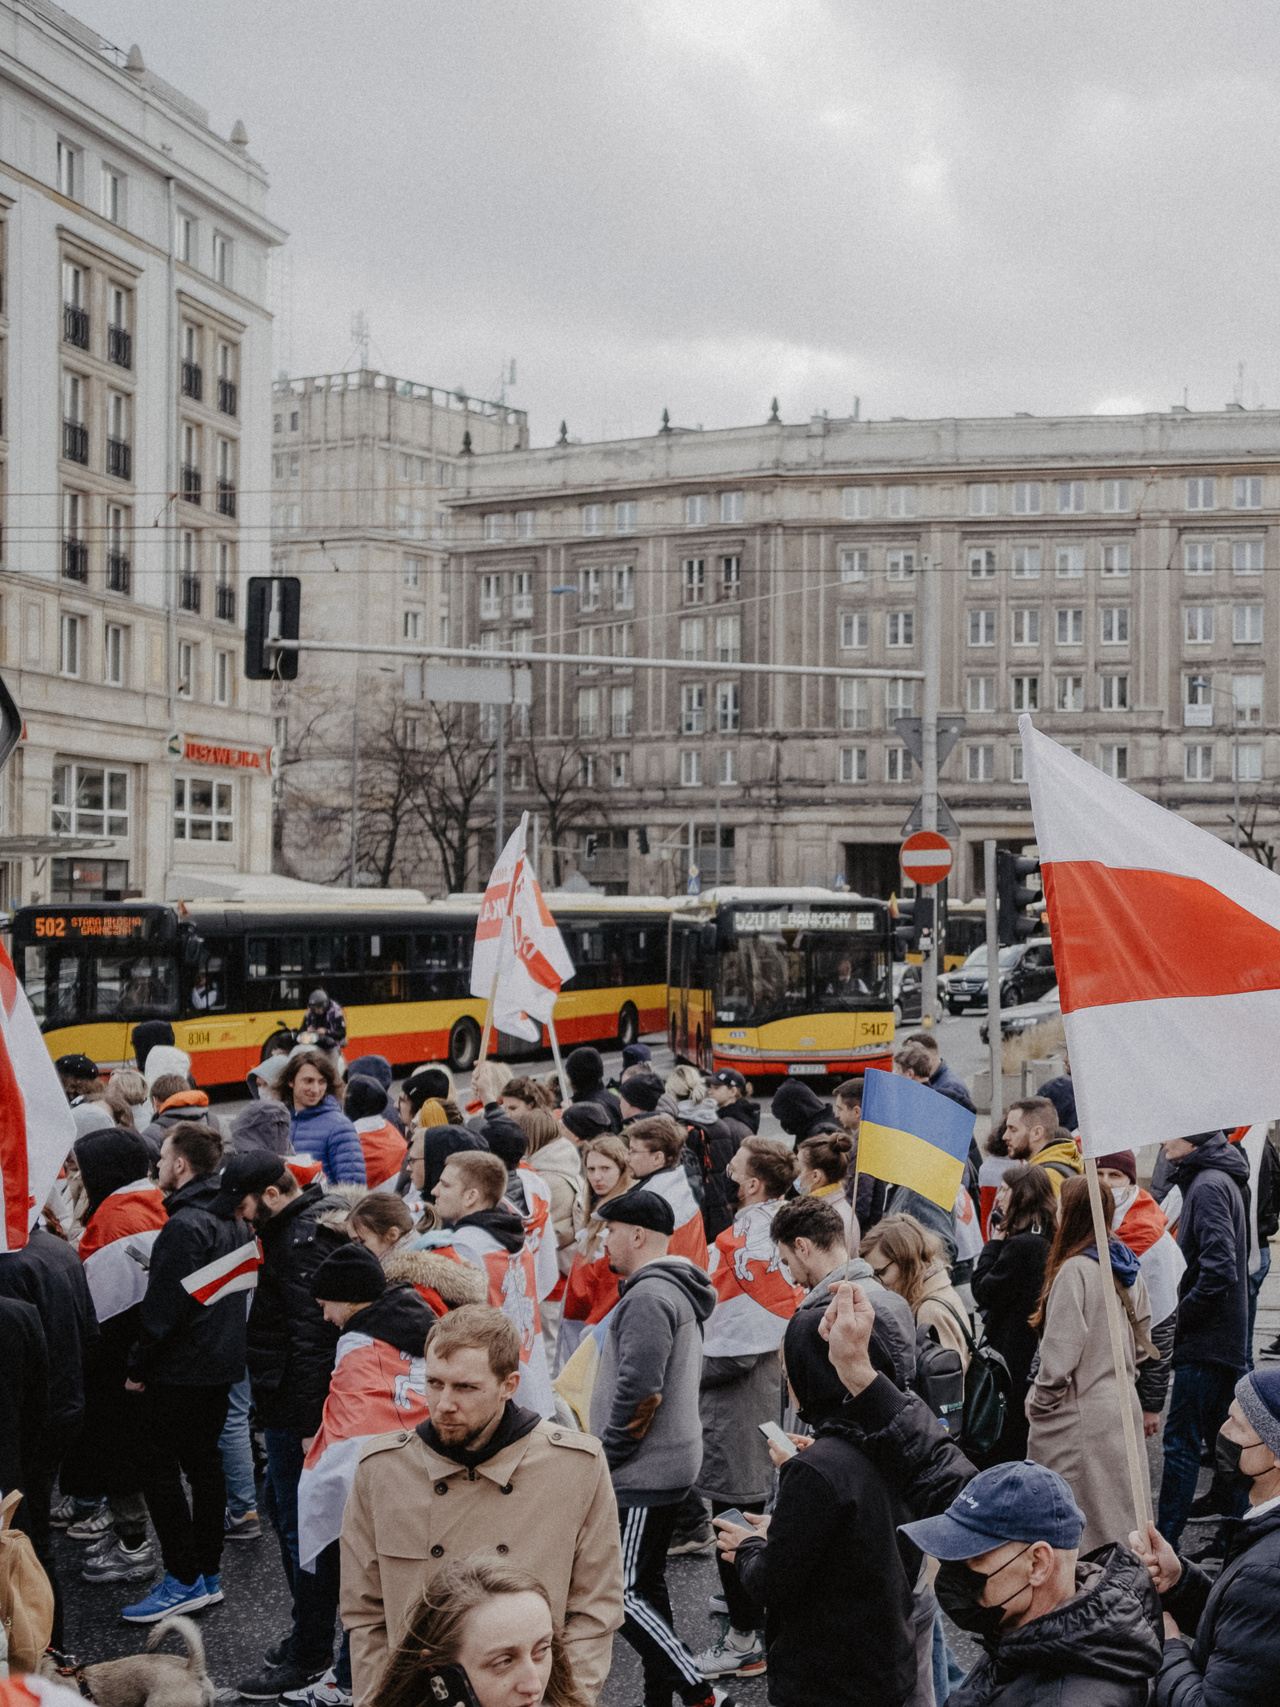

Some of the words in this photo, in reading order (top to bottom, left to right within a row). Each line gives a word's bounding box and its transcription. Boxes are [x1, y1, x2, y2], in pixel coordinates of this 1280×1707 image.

[35, 917, 66, 937] 502
[735, 912, 764, 930] 520
[861, 1023, 888, 1036] 5417
[188, 1031, 210, 1045] 8304
